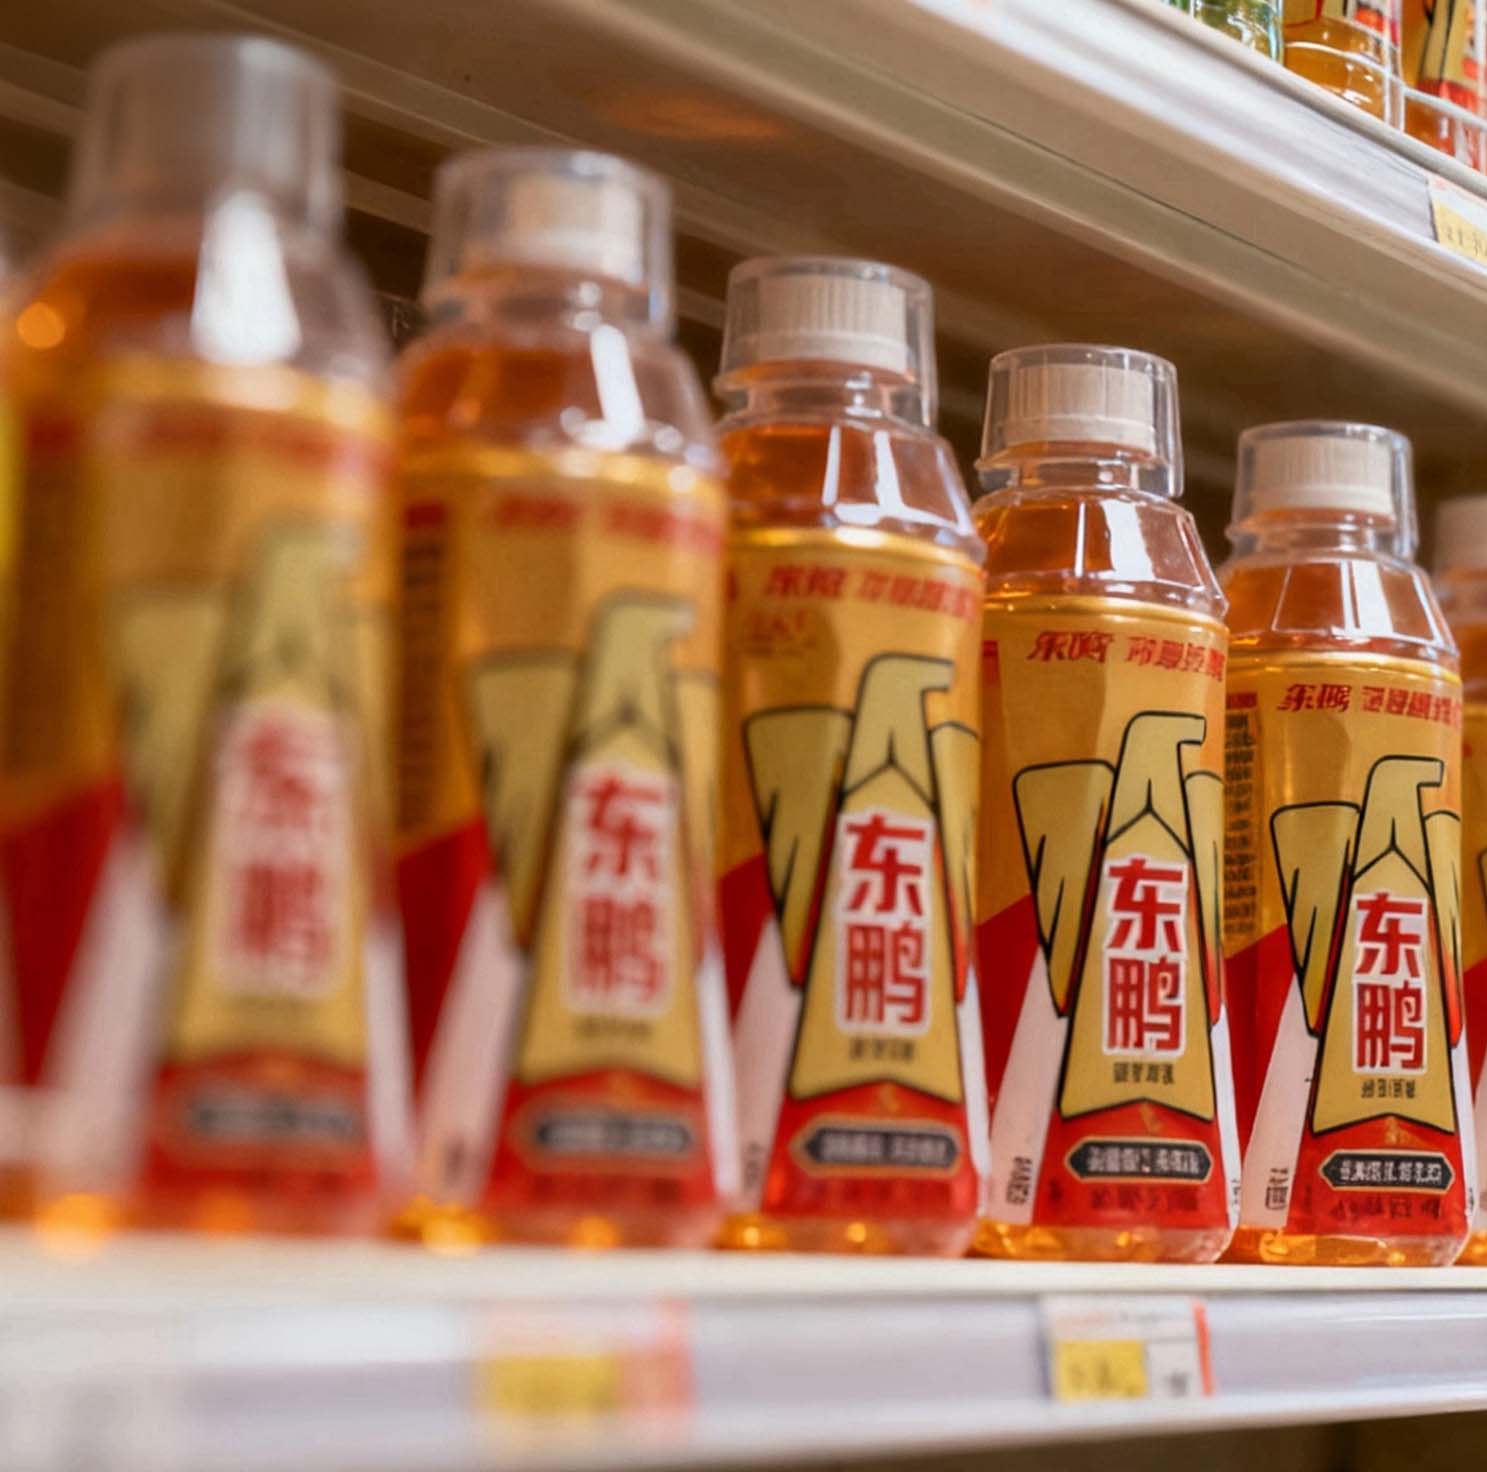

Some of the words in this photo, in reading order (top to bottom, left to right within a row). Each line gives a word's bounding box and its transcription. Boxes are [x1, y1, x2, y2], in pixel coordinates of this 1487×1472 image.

[576, 775, 666, 1001] 东鹏
[846, 814, 926, 1024] 东鹏
[1108, 857, 1183, 1052] 东鹏
[1356, 892, 1425, 1070] 东鹏
